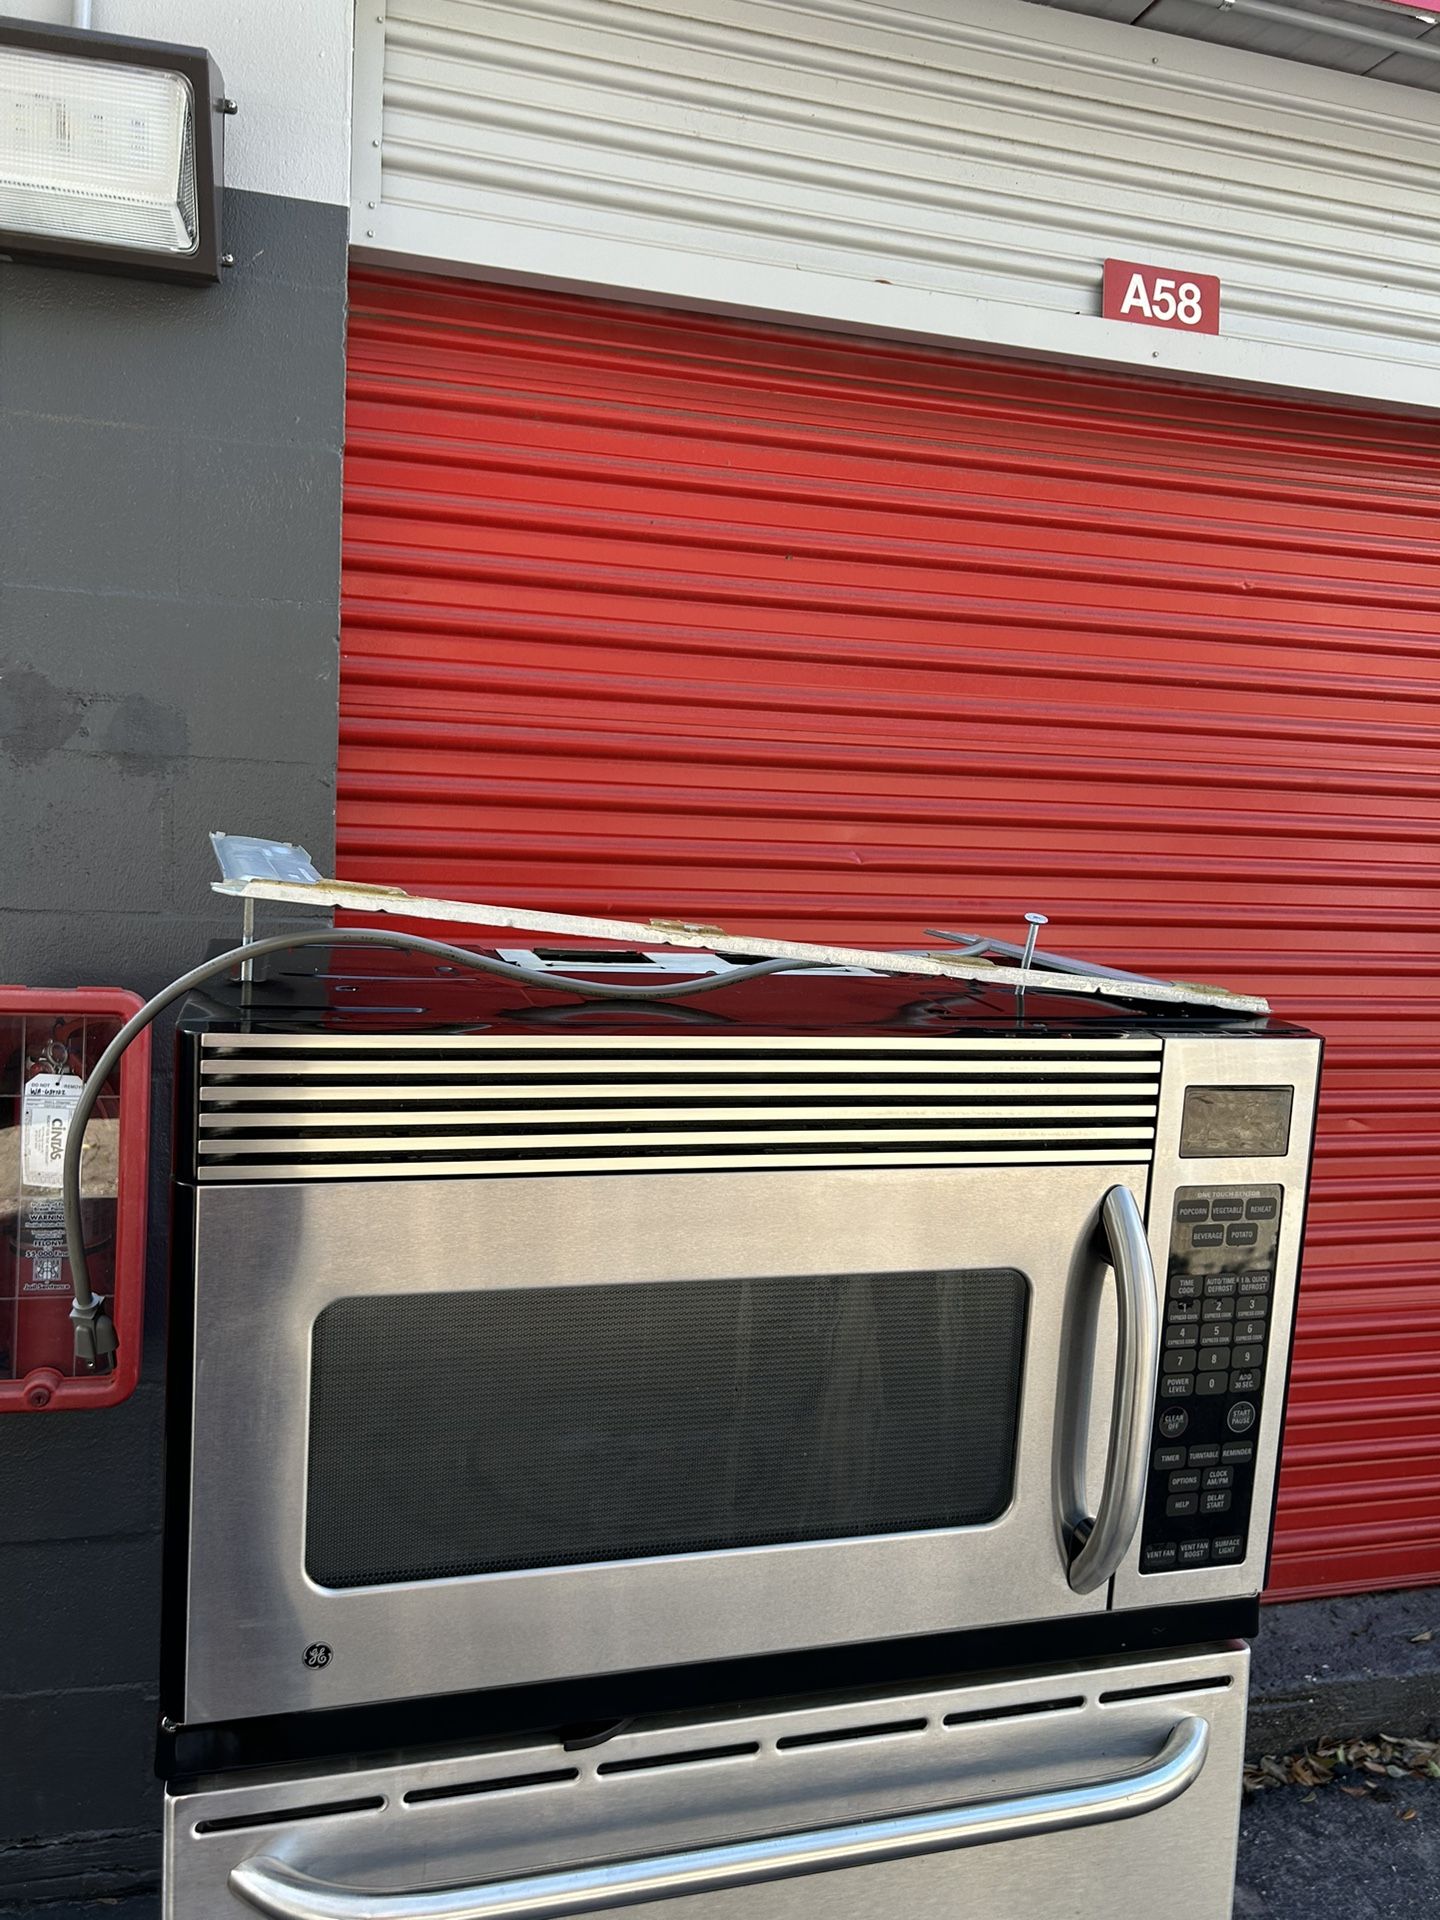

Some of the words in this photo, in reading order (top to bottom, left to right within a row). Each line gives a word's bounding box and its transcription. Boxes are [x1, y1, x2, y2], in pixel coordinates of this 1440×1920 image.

[1120, 273, 1202, 325] A58
[1250, 1205, 1272, 1213] REHEAT
[1193, 1232, 1223, 1240] BEVERAGE
[1241, 1283, 1266, 1291] DEFROST
[1216, 1302, 1221, 1311] 2
[1249, 1300, 1255, 1309] 3
[1180, 1328, 1185, 1337] 4
[1214, 1326, 1219, 1335] 5
[1247, 1324, 1253, 1333] 6
[1177, 1356, 1183, 1366] 7
[1211, 1354, 1217, 1364] 8
[1244, 1352, 1251, 1361] 9
[1167, 1378, 1189, 1386] POWER
[1209, 1379, 1215, 1388] 0
[1168, 1385, 1185, 1393] LEVEL
[1231, 1417, 1250, 1425] PAUSE
[1189, 1451, 1219, 1459] TURNTABLE
[1222, 1448, 1252, 1457] REMINDER
[1172, 1477, 1197, 1485] OPTIONS
[1206, 1478, 1229, 1486] AM/PM
[1206, 1501, 1225, 1509] START
[1215, 1539, 1240, 1548] SURFACE
[1184, 1550, 1204, 1558] BOOST
